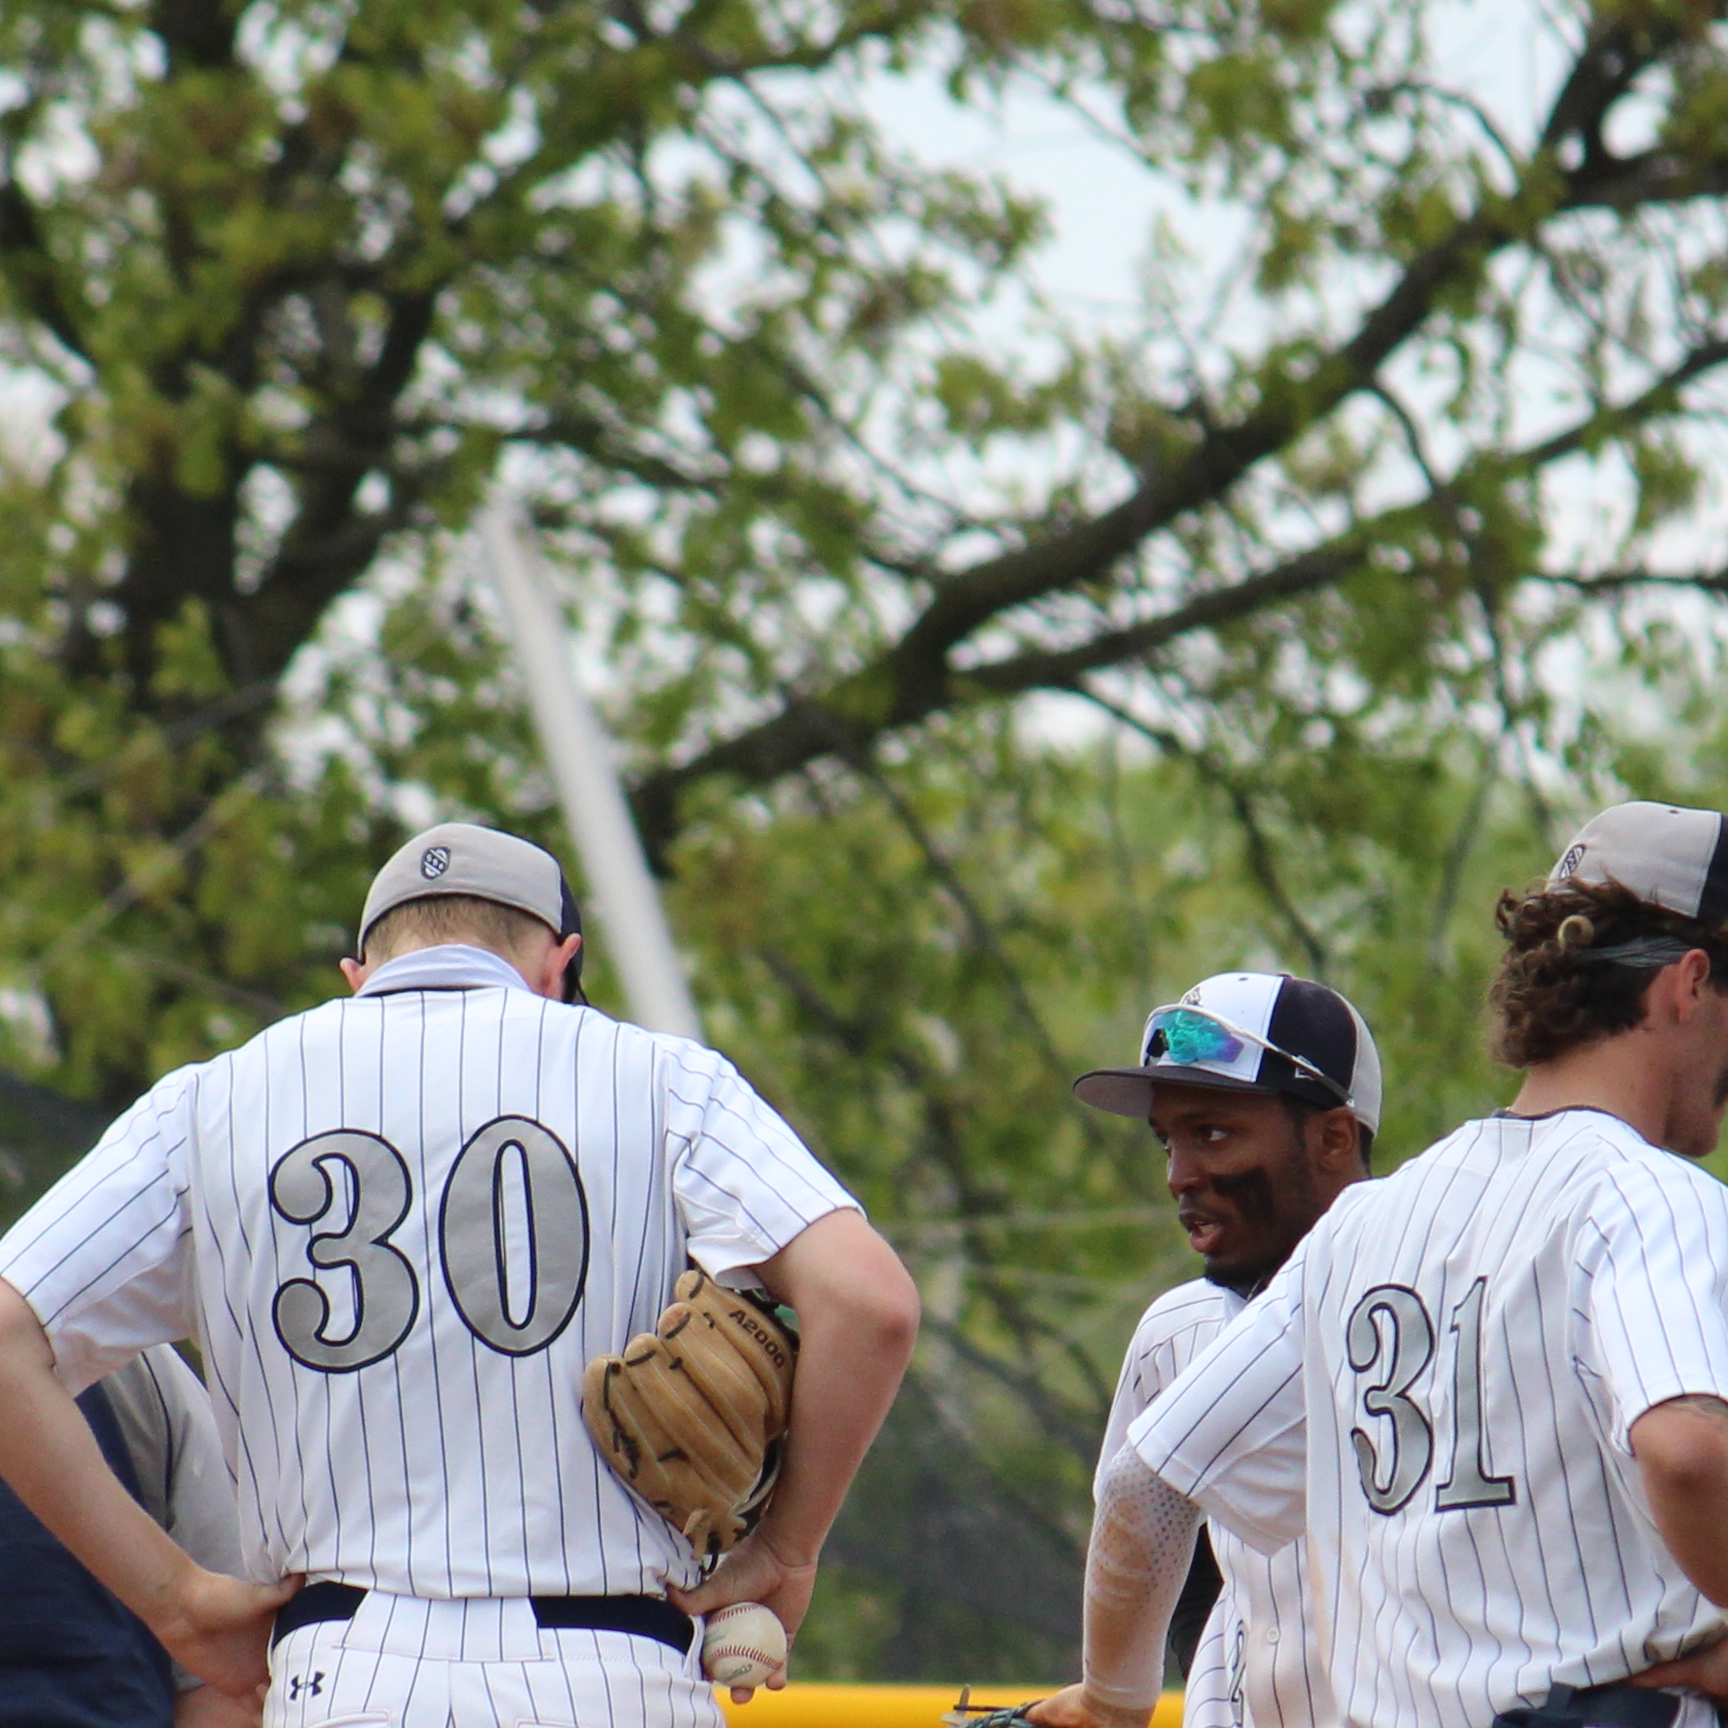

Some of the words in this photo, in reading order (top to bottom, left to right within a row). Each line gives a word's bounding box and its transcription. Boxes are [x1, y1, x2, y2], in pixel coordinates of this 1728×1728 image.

[267, 1113, 591, 1375] 30
[728, 1309, 785, 1369] A2000
[1345, 1275, 1517, 1517] 31
